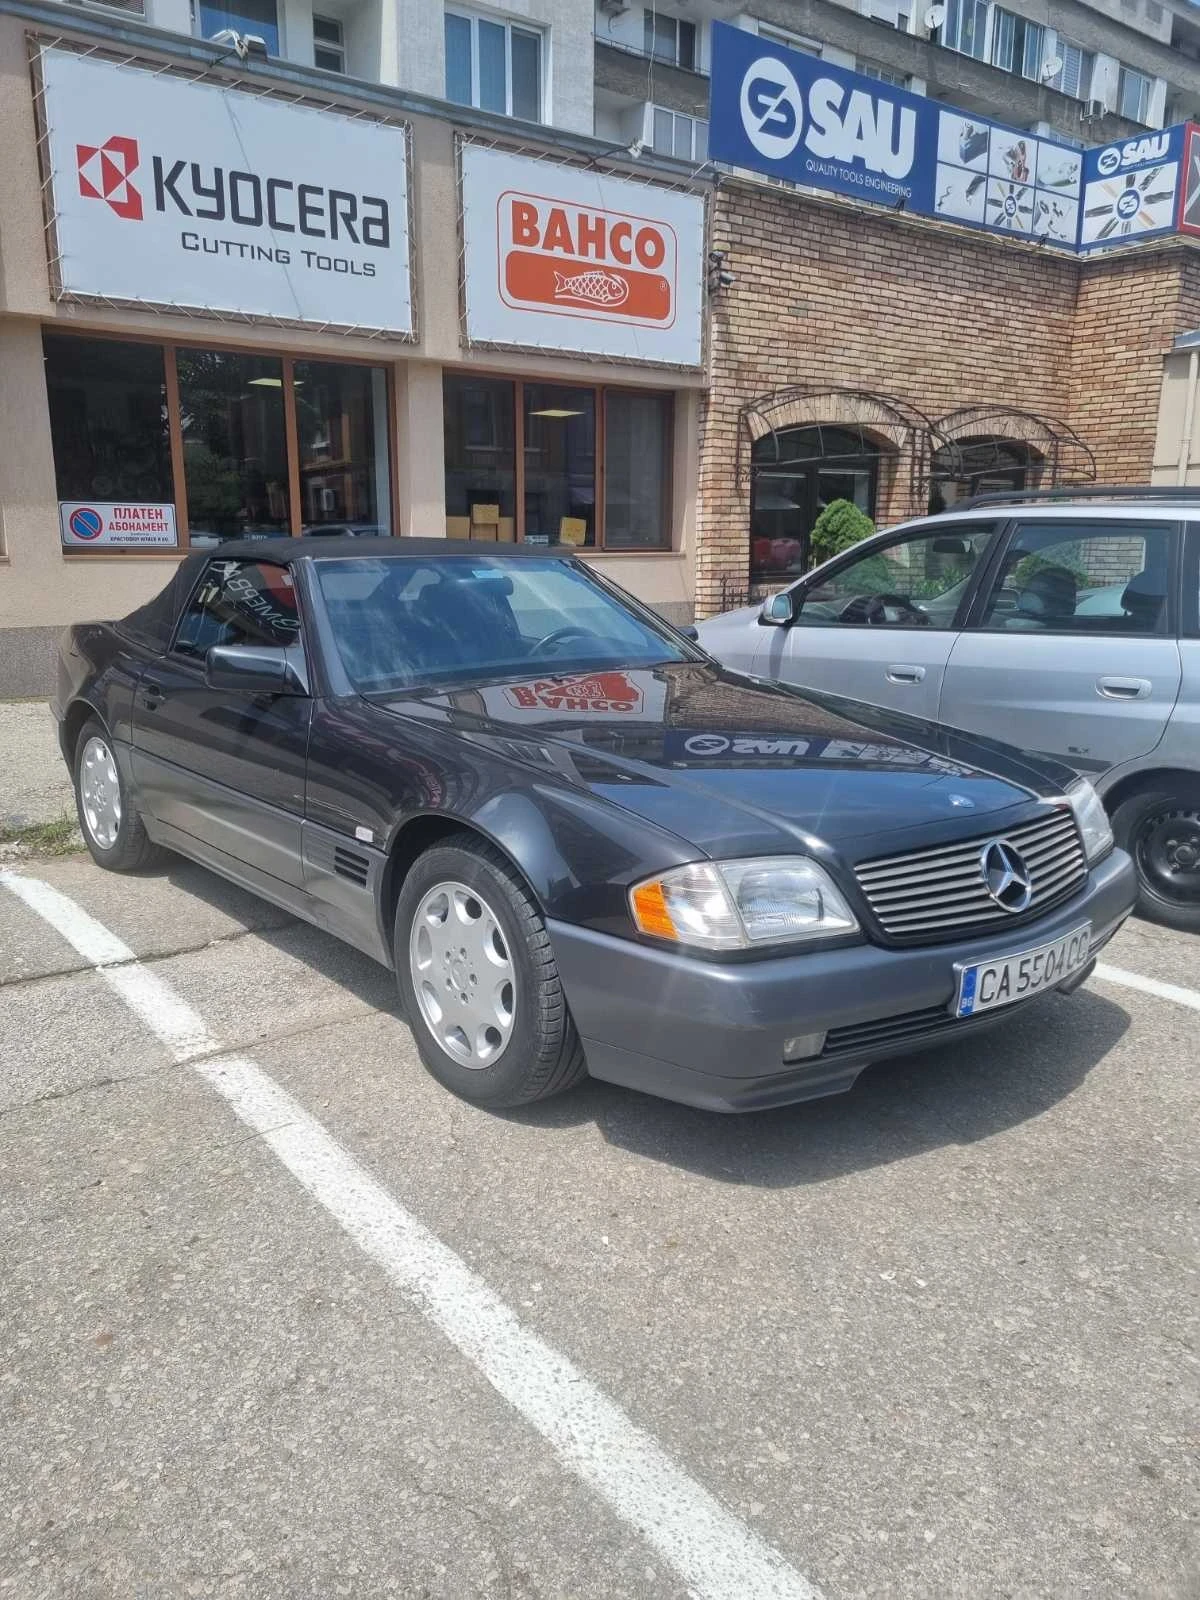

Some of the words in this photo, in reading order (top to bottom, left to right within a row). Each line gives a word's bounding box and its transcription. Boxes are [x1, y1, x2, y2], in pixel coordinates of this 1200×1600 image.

[804, 78, 917, 179] SAU
[1119, 132, 1170, 166] SAU
[152, 155, 390, 248] KYOCERA
[805, 159, 838, 177] QUALITY
[839, 168, 864, 185] TOOLS
[865, 175, 912, 199] ENGINEERING
[181, 231, 291, 265] CUTTING
[300, 249, 376, 277] TOOLS
[511, 199, 666, 270] BAHCO
[108, 521, 169, 532] АБОНАМЕНТ
[113, 507, 163, 520] ПЛАТЕН
[979, 963, 1010, 1003] CA
[1016, 942, 1066, 993] 5504
